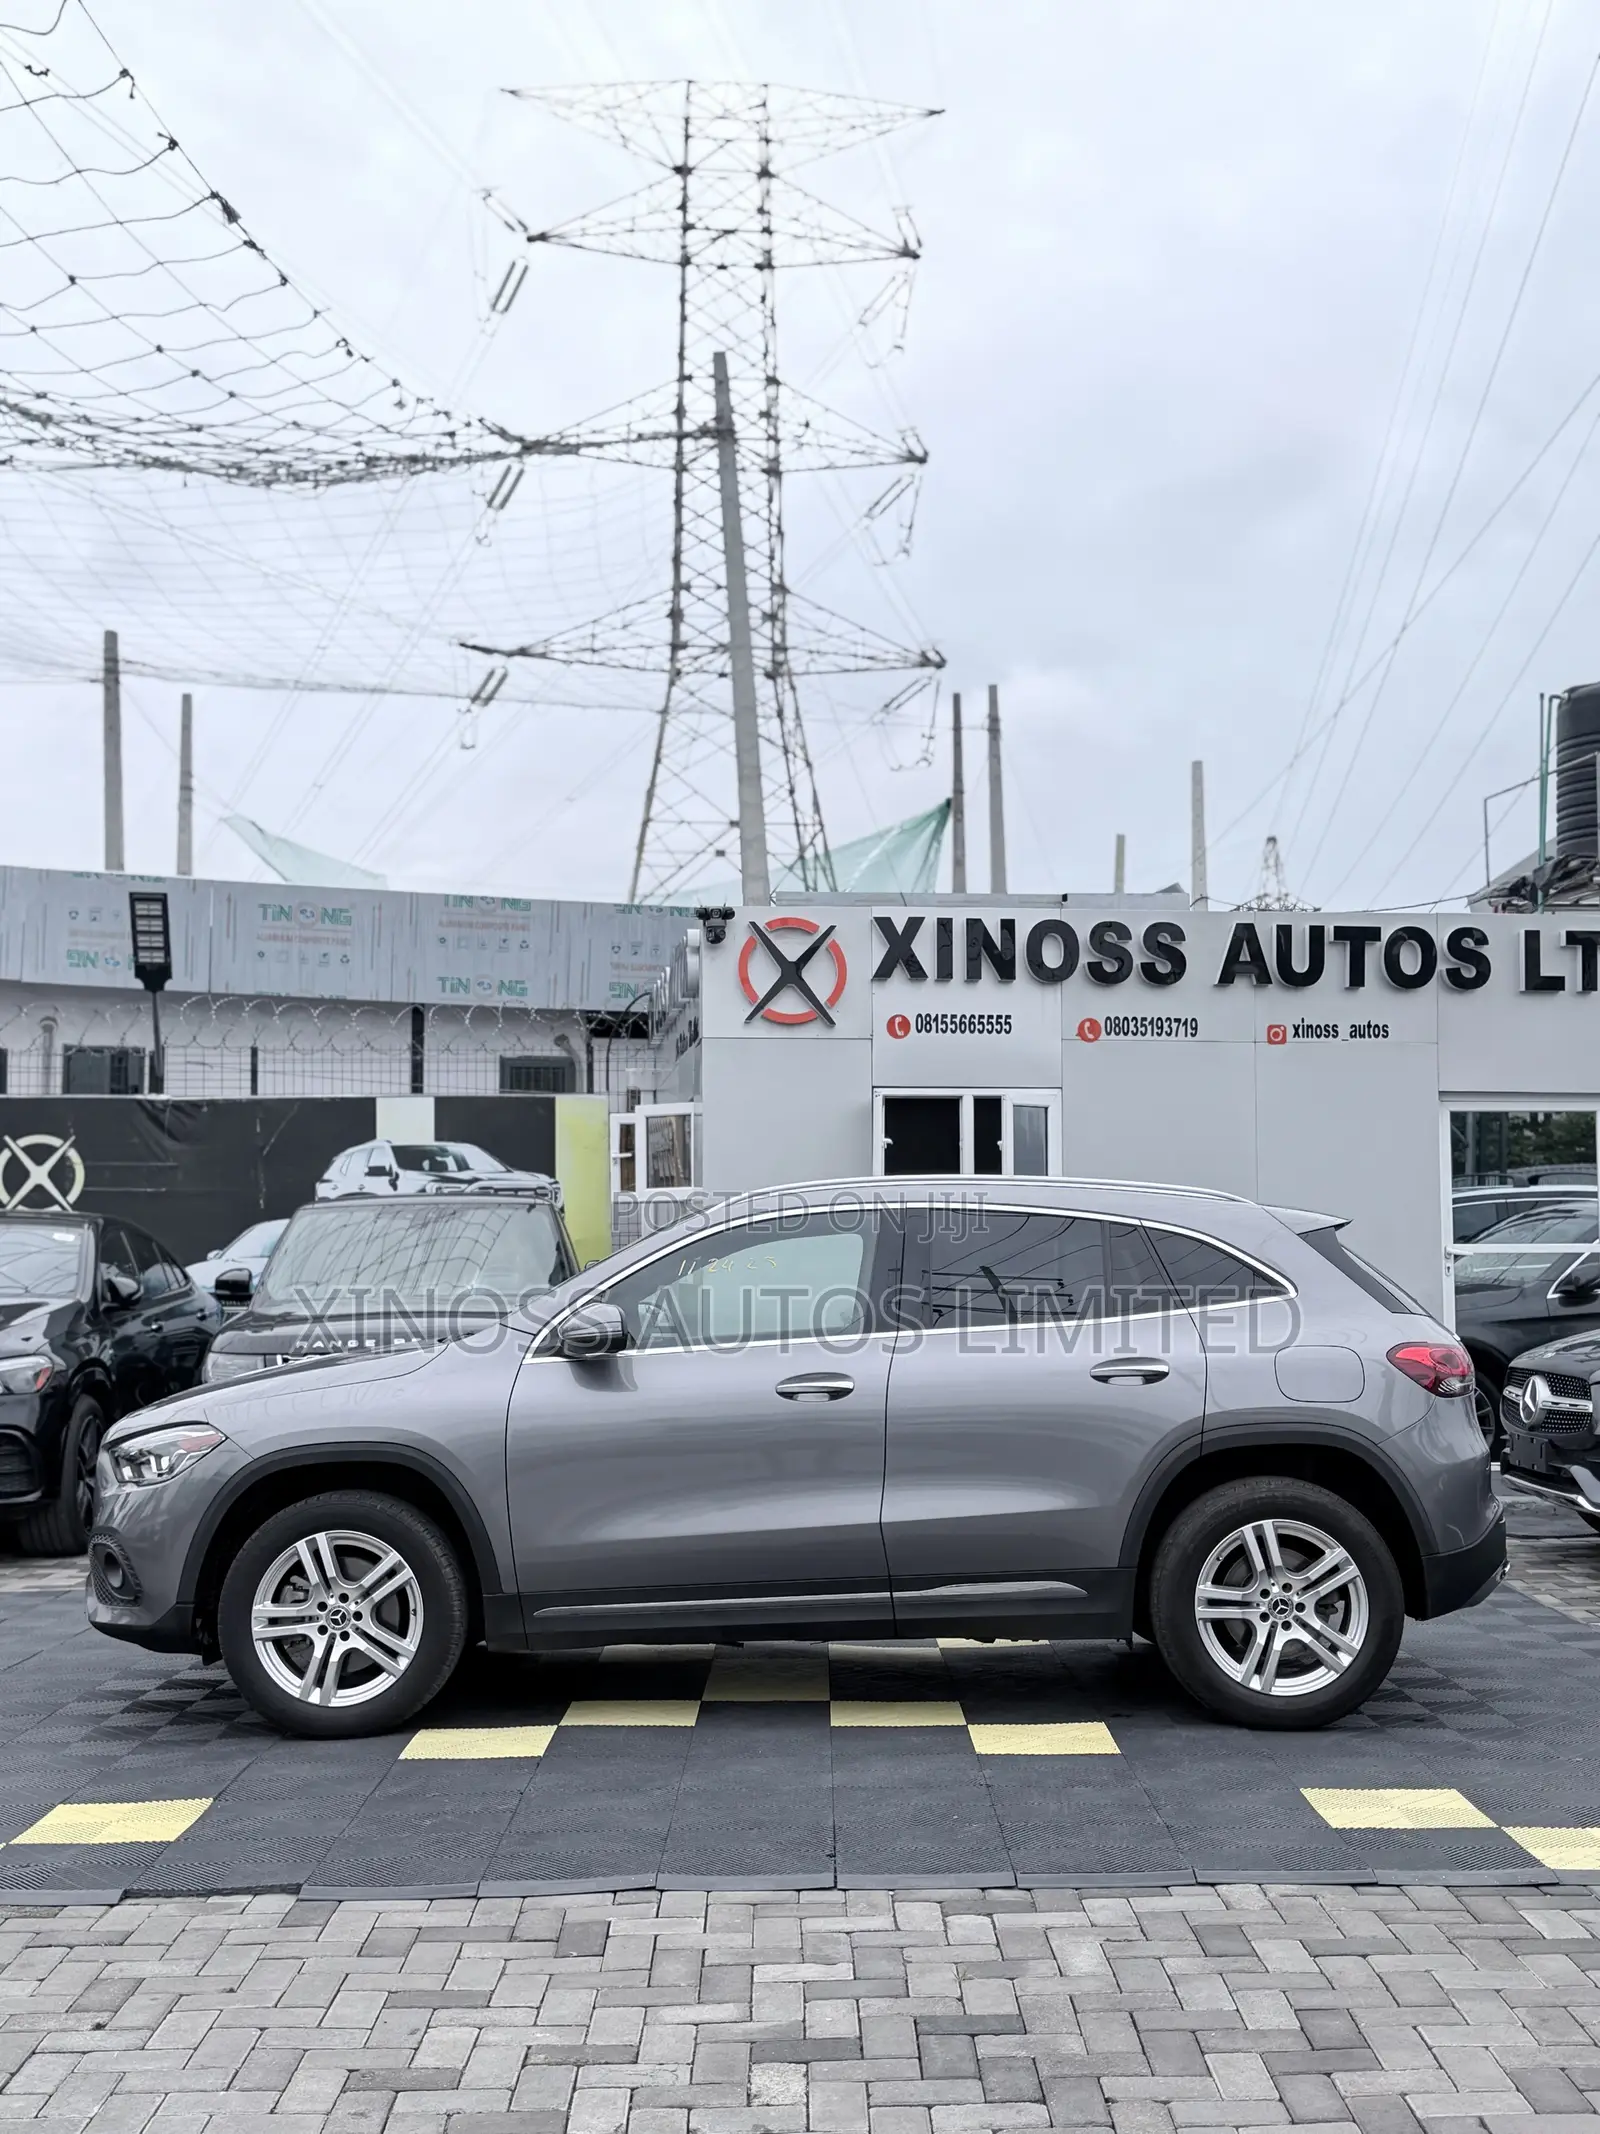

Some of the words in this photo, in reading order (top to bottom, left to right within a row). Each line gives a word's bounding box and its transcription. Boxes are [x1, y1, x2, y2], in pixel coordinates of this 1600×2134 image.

[871, 916, 1187, 986] XINOSS
[1214, 922, 1491, 991] AUTOS
[915, 1013, 1012, 1035] 08155665555
[1104, 1016, 1198, 1038] 08035193719
[296, 1338, 376, 1349] RANGE
